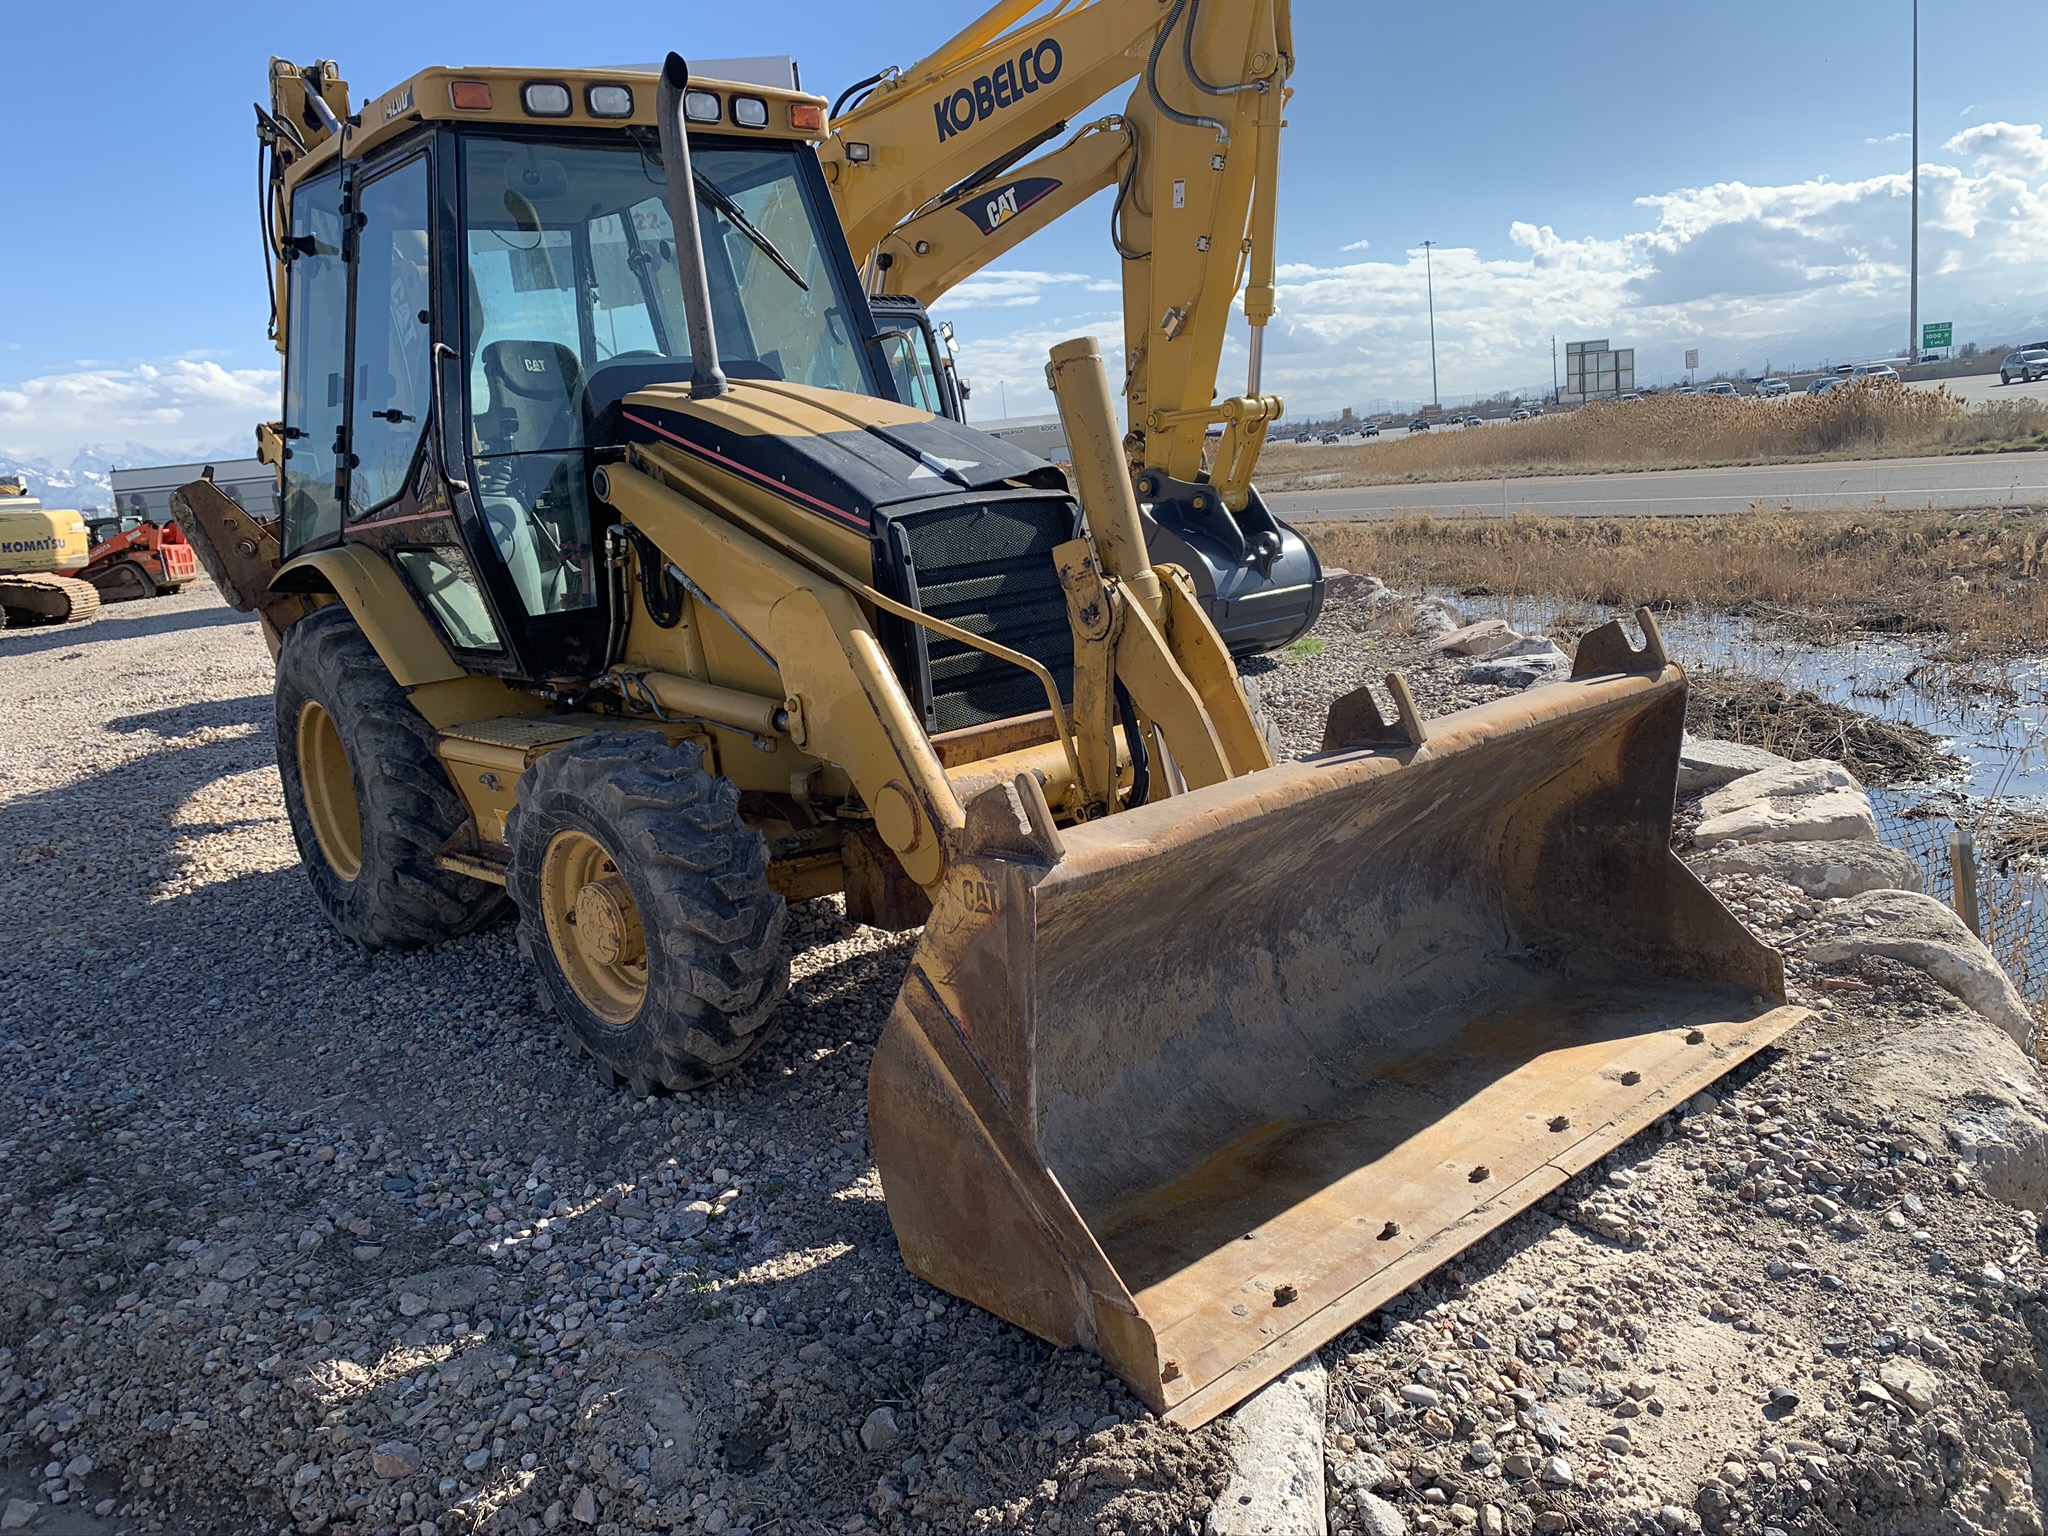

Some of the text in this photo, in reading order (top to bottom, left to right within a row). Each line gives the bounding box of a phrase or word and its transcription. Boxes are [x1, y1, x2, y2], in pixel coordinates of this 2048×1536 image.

[933, 38, 1063, 143] KOBELCO
[986, 186, 1018, 228] CAT
[390, 276, 417, 347] CAT
[524, 359, 546, 371] CAT
[2, 538, 66, 554] KOMATSU
[88, 543, 112, 559] KUBOTA
[962, 879, 998, 913] CAT
